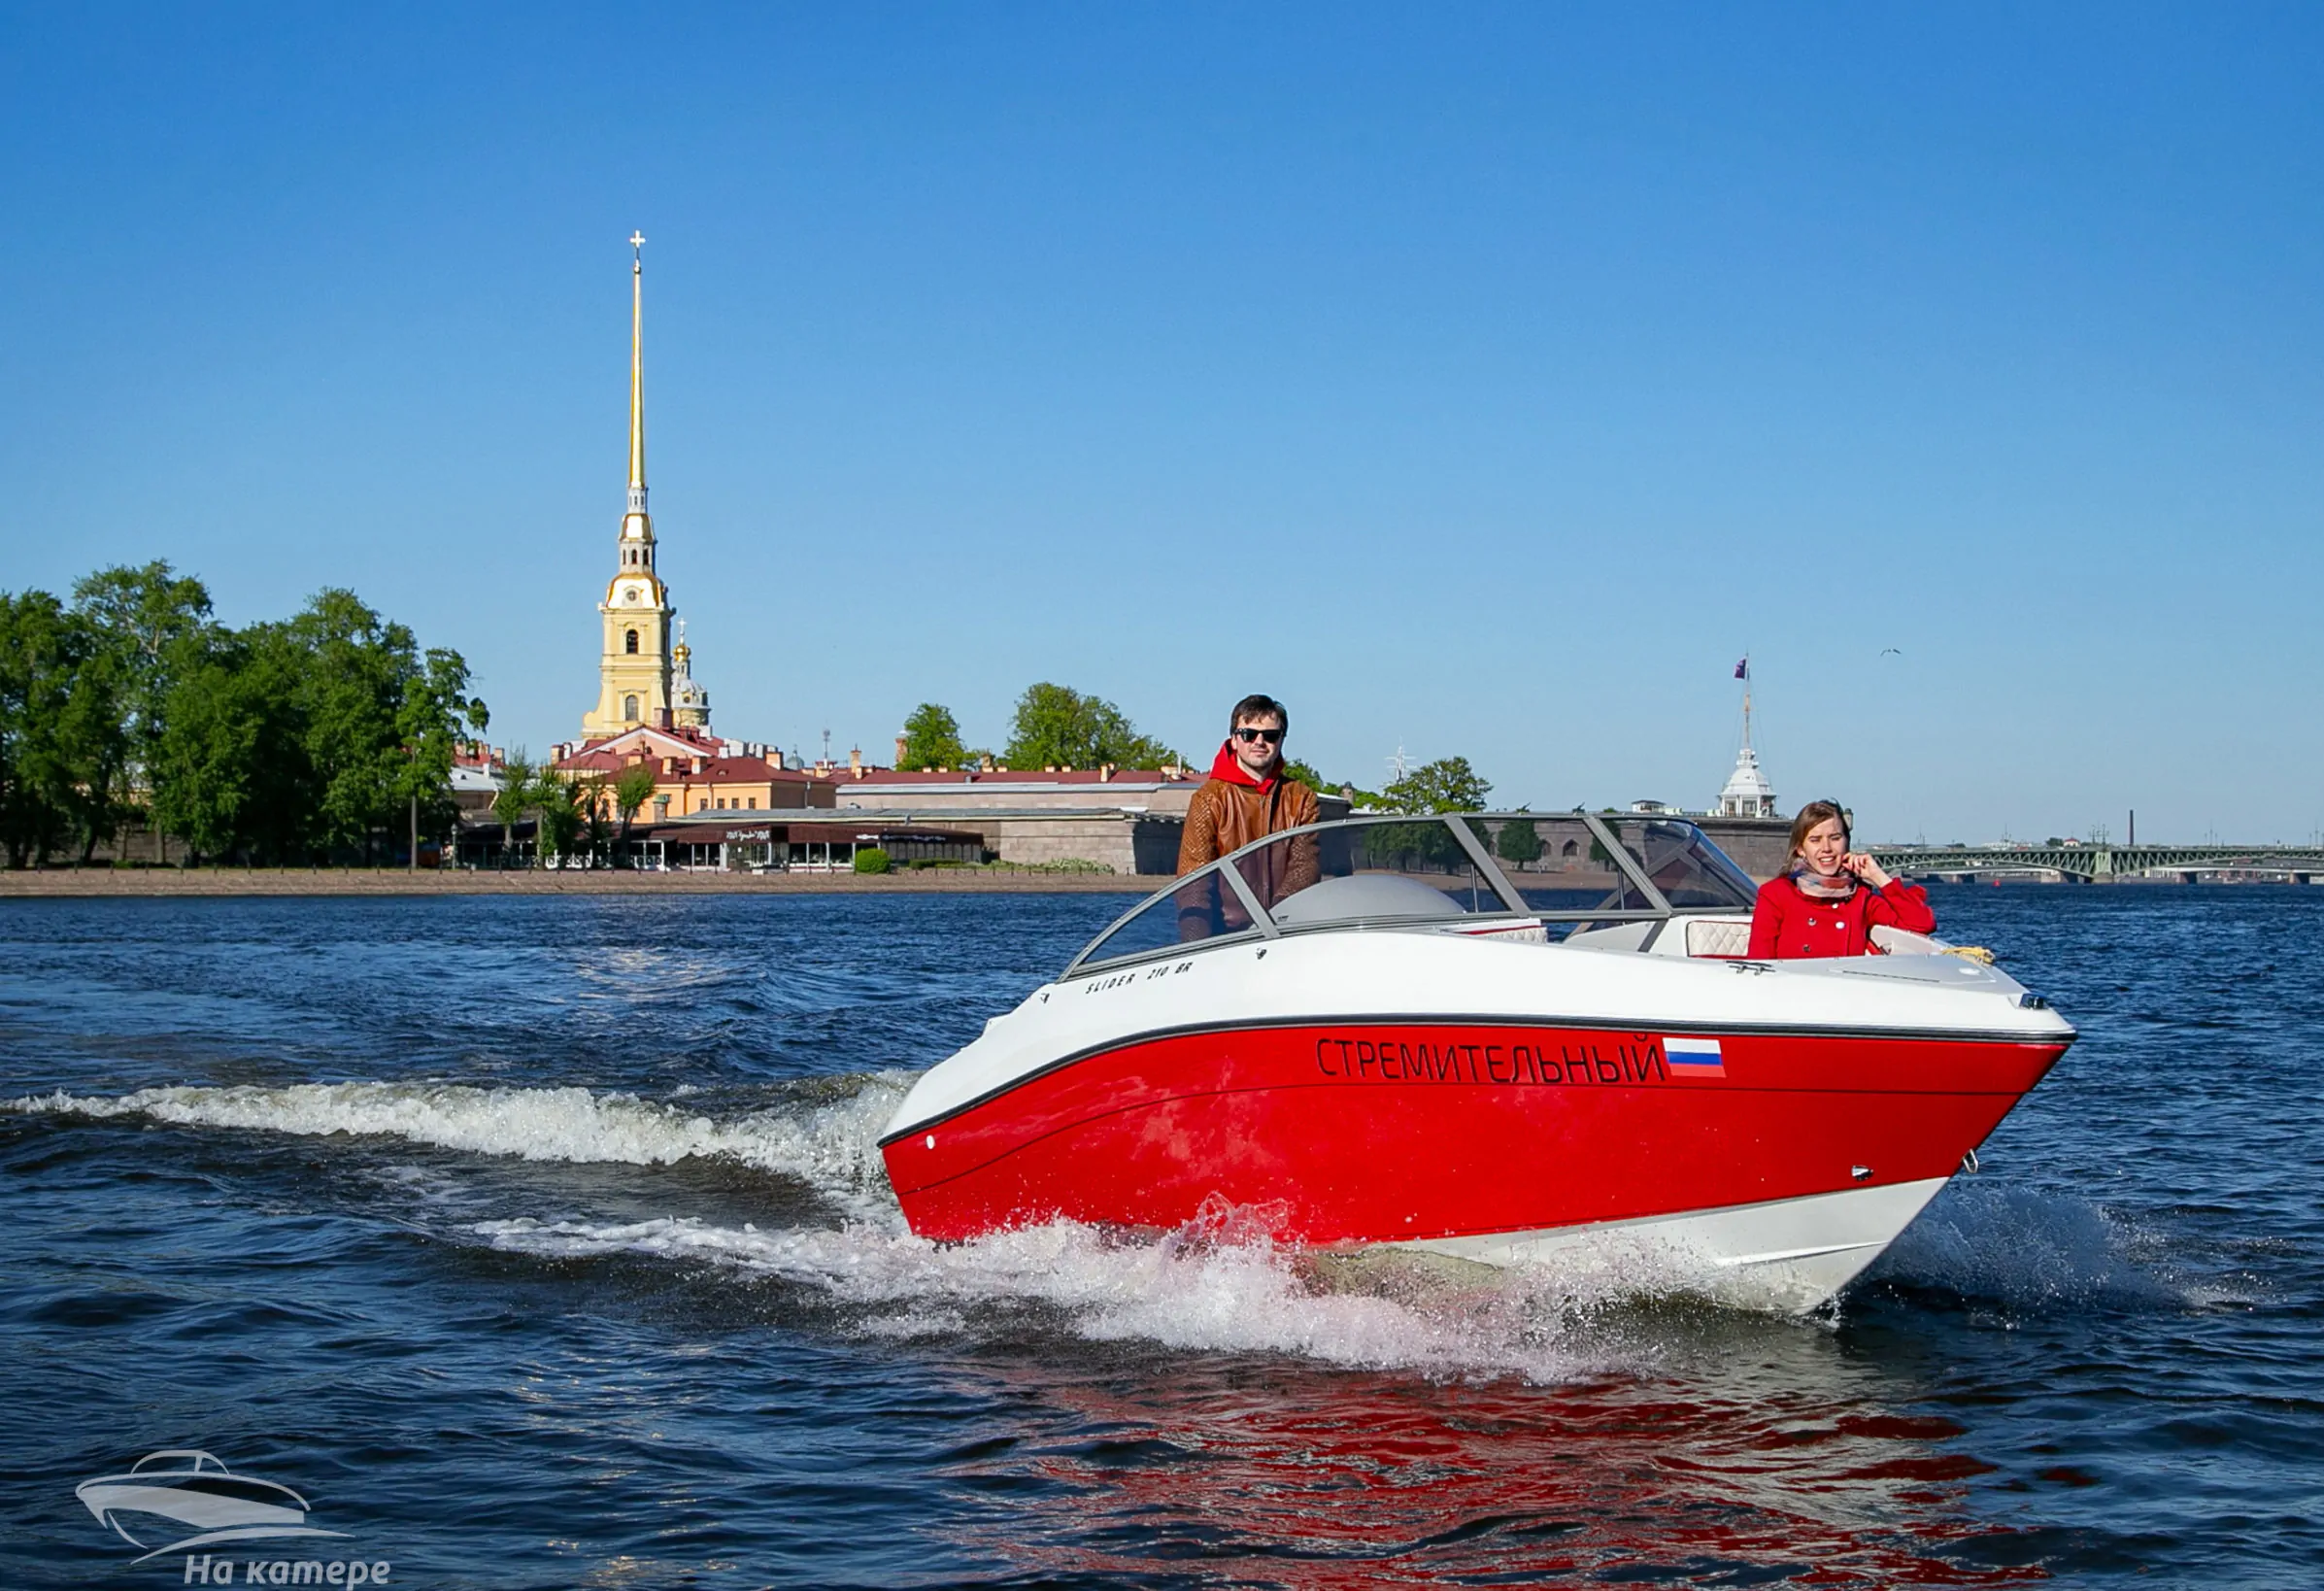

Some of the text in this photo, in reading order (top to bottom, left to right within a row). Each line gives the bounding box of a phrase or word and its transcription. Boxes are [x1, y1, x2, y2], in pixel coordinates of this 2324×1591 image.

[1086, 962, 1194, 995] SLIDER 210 BR
[1316, 1033, 1666, 1083] СТРЕМИТЕЛЬНЫЙ
